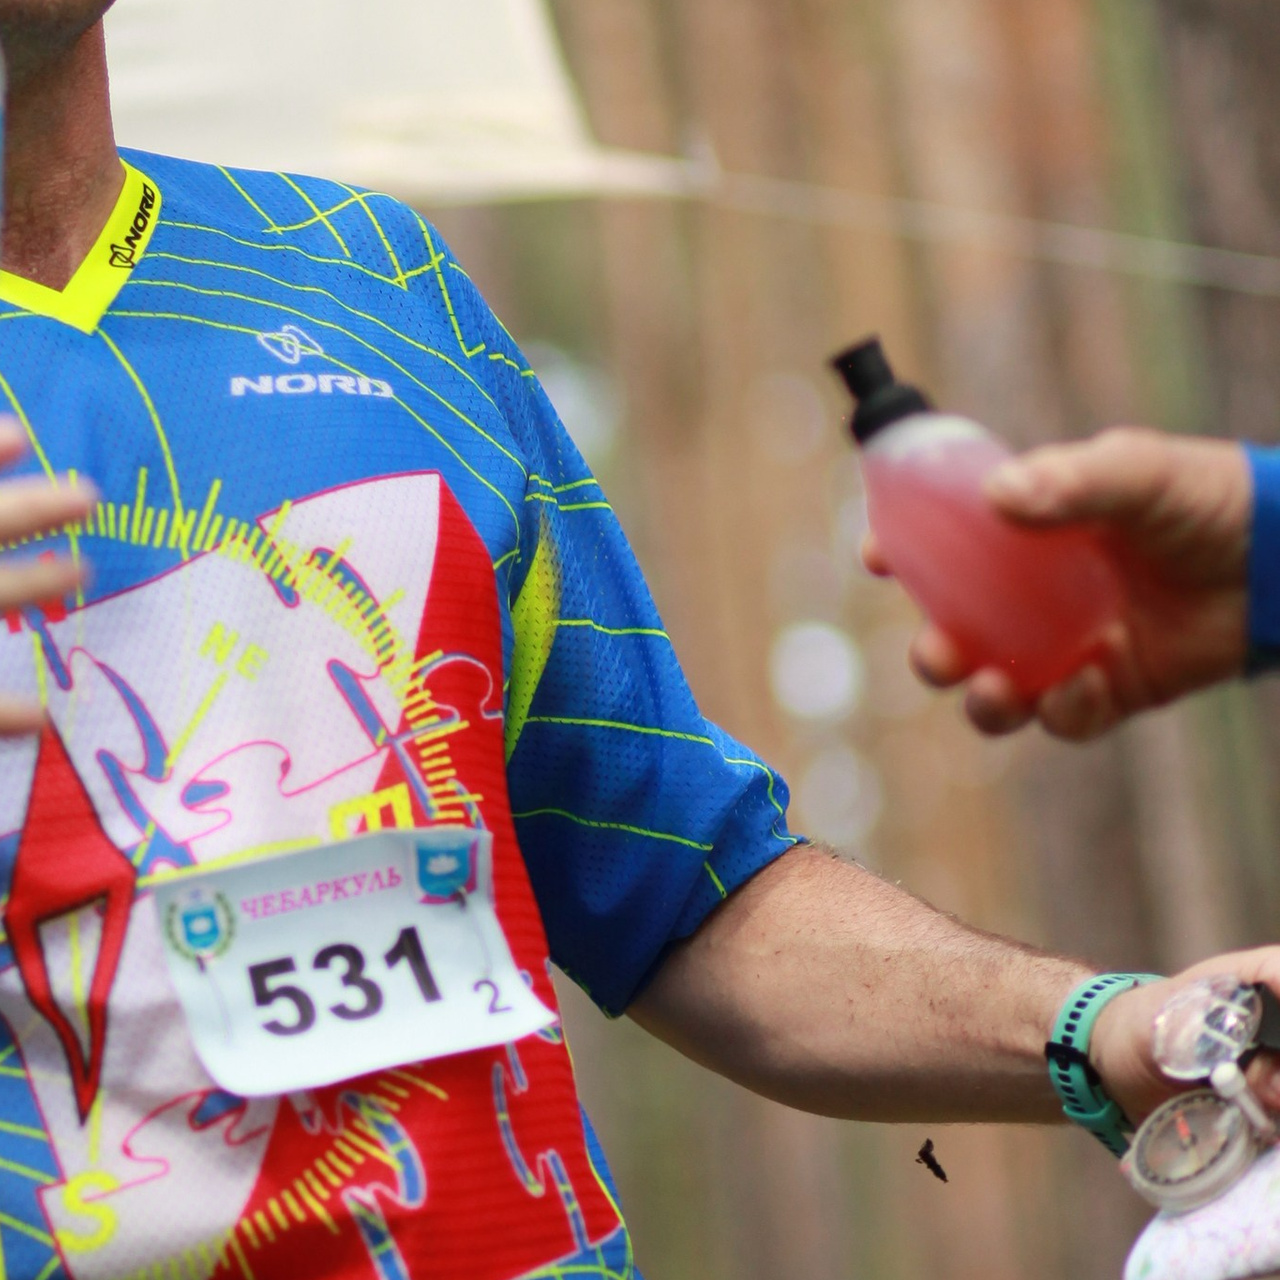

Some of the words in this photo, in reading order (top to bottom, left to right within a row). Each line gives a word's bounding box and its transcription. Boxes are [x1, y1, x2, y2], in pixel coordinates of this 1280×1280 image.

[124, 182, 155, 250] NORD
[230, 373, 394, 398] NORD
[199, 620, 269, 682] NE
[240, 866, 403, 918] ЧЕБАРКУЛЬ
[247, 925, 443, 1036] 531
[472, 978, 513, 1014] 2
[55, 1170, 119, 1254] S
